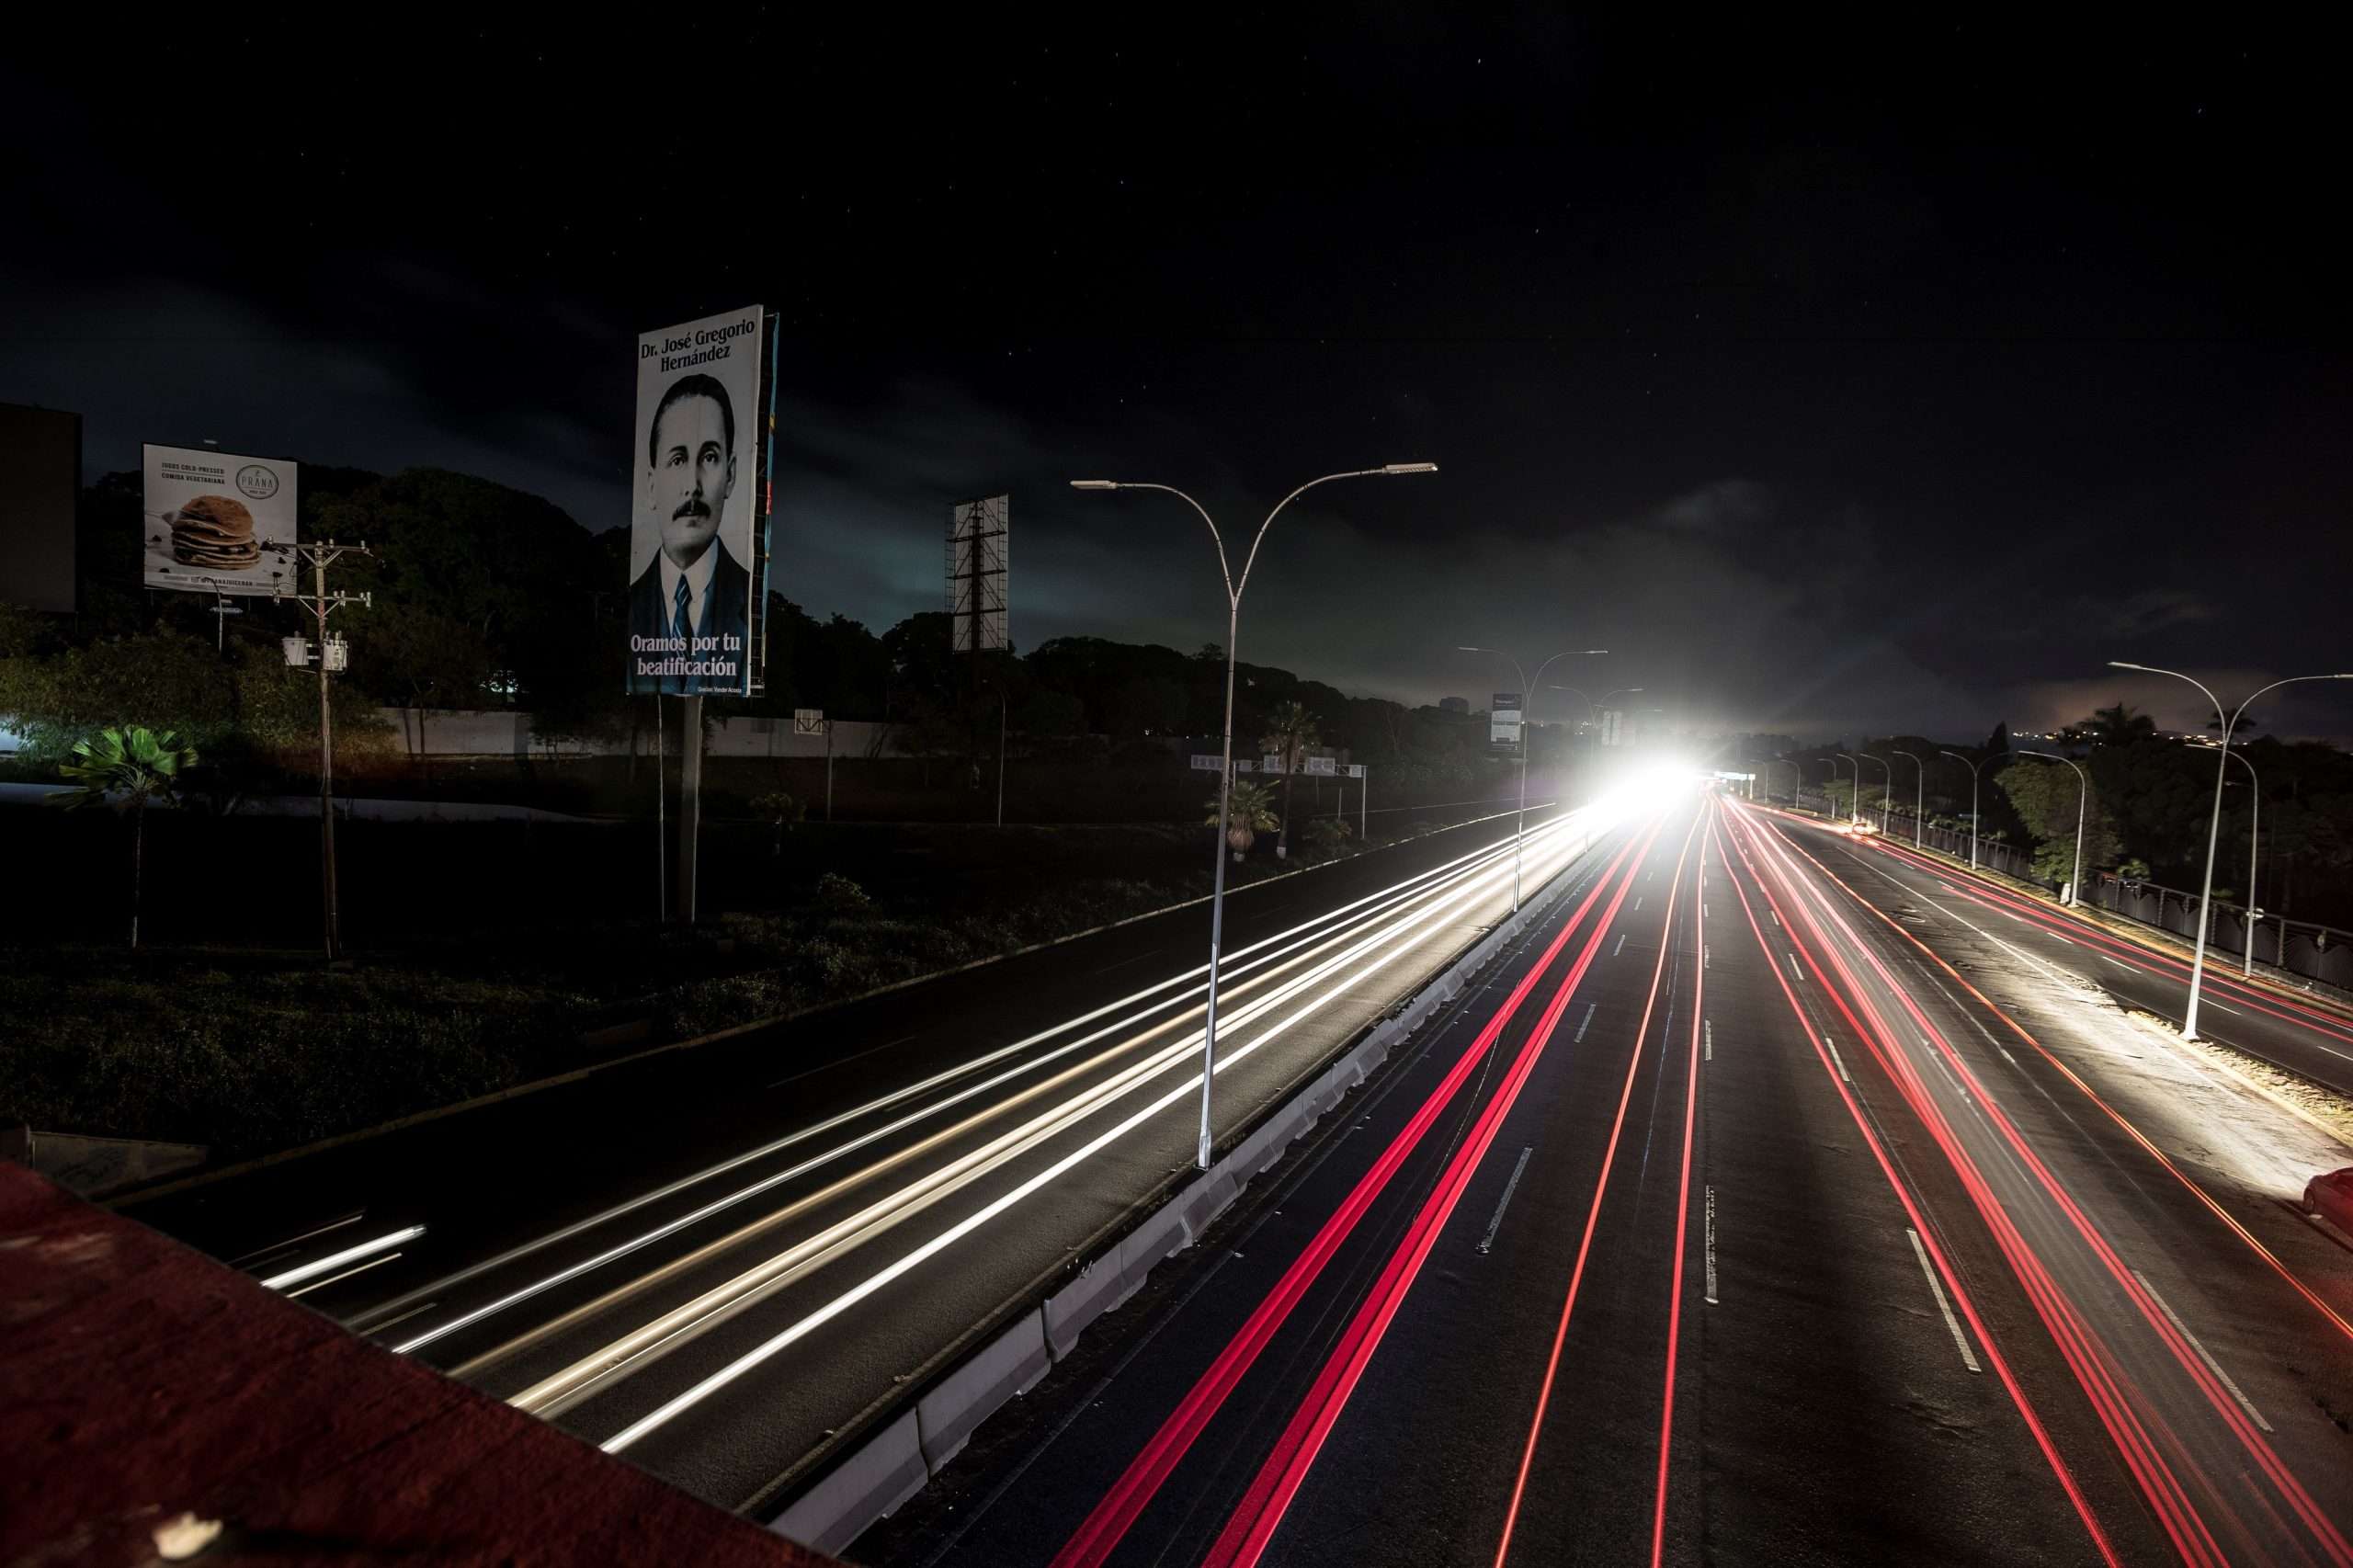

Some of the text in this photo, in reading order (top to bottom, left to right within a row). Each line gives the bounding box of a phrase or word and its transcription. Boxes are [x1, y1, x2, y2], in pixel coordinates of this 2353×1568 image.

[642, 319, 755, 358] Dr. José Gregorio
[661, 345, 731, 372] Hernández
[161, 472, 225, 484] COMIDA VEGETARIANA
[181, 464, 225, 474] COLD-PRESSED
[241, 475, 274, 489] PRANA
[631, 632, 741, 656] Oramos por tu
[637, 656, 736, 676] beatificación
